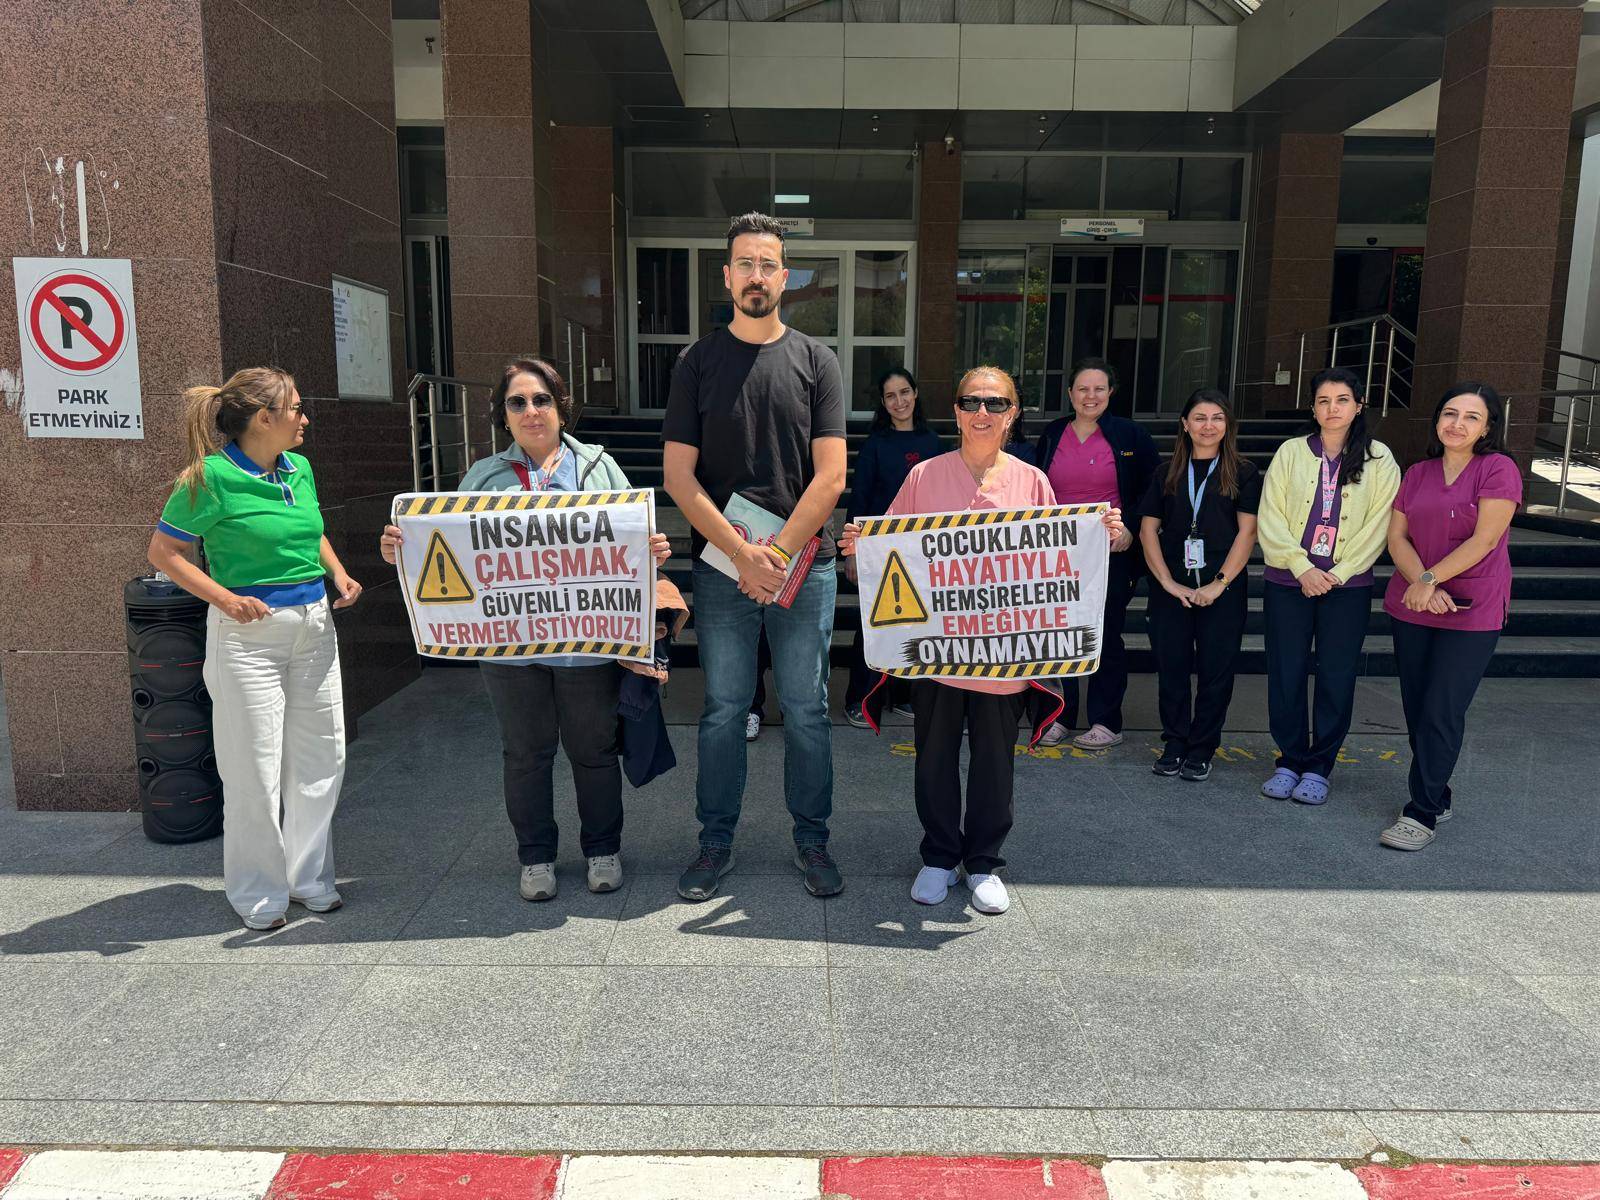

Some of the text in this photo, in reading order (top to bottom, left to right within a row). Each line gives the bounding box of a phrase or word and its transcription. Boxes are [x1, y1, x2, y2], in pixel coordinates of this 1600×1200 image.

[58, 389, 109, 405] PARK
[29, 410, 131, 429] ETMEYİNİZ
[469, 510, 615, 550] İNSANCA
[921, 519, 1078, 564] ÇOCUKLARIN
[475, 544, 638, 590] ÇALIŞMAK,
[928, 549, 1080, 588] HAYATIYLA,
[482, 587, 641, 618] GÜVENLİ BAKIM
[931, 579, 1081, 613] HEMŞİRELERİN
[429, 613, 641, 645] VERMEK İSTİYORUZ!
[942, 606, 1069, 636] EMEĞİYLE
[918, 629, 1083, 664] OYNAMAYIN!
